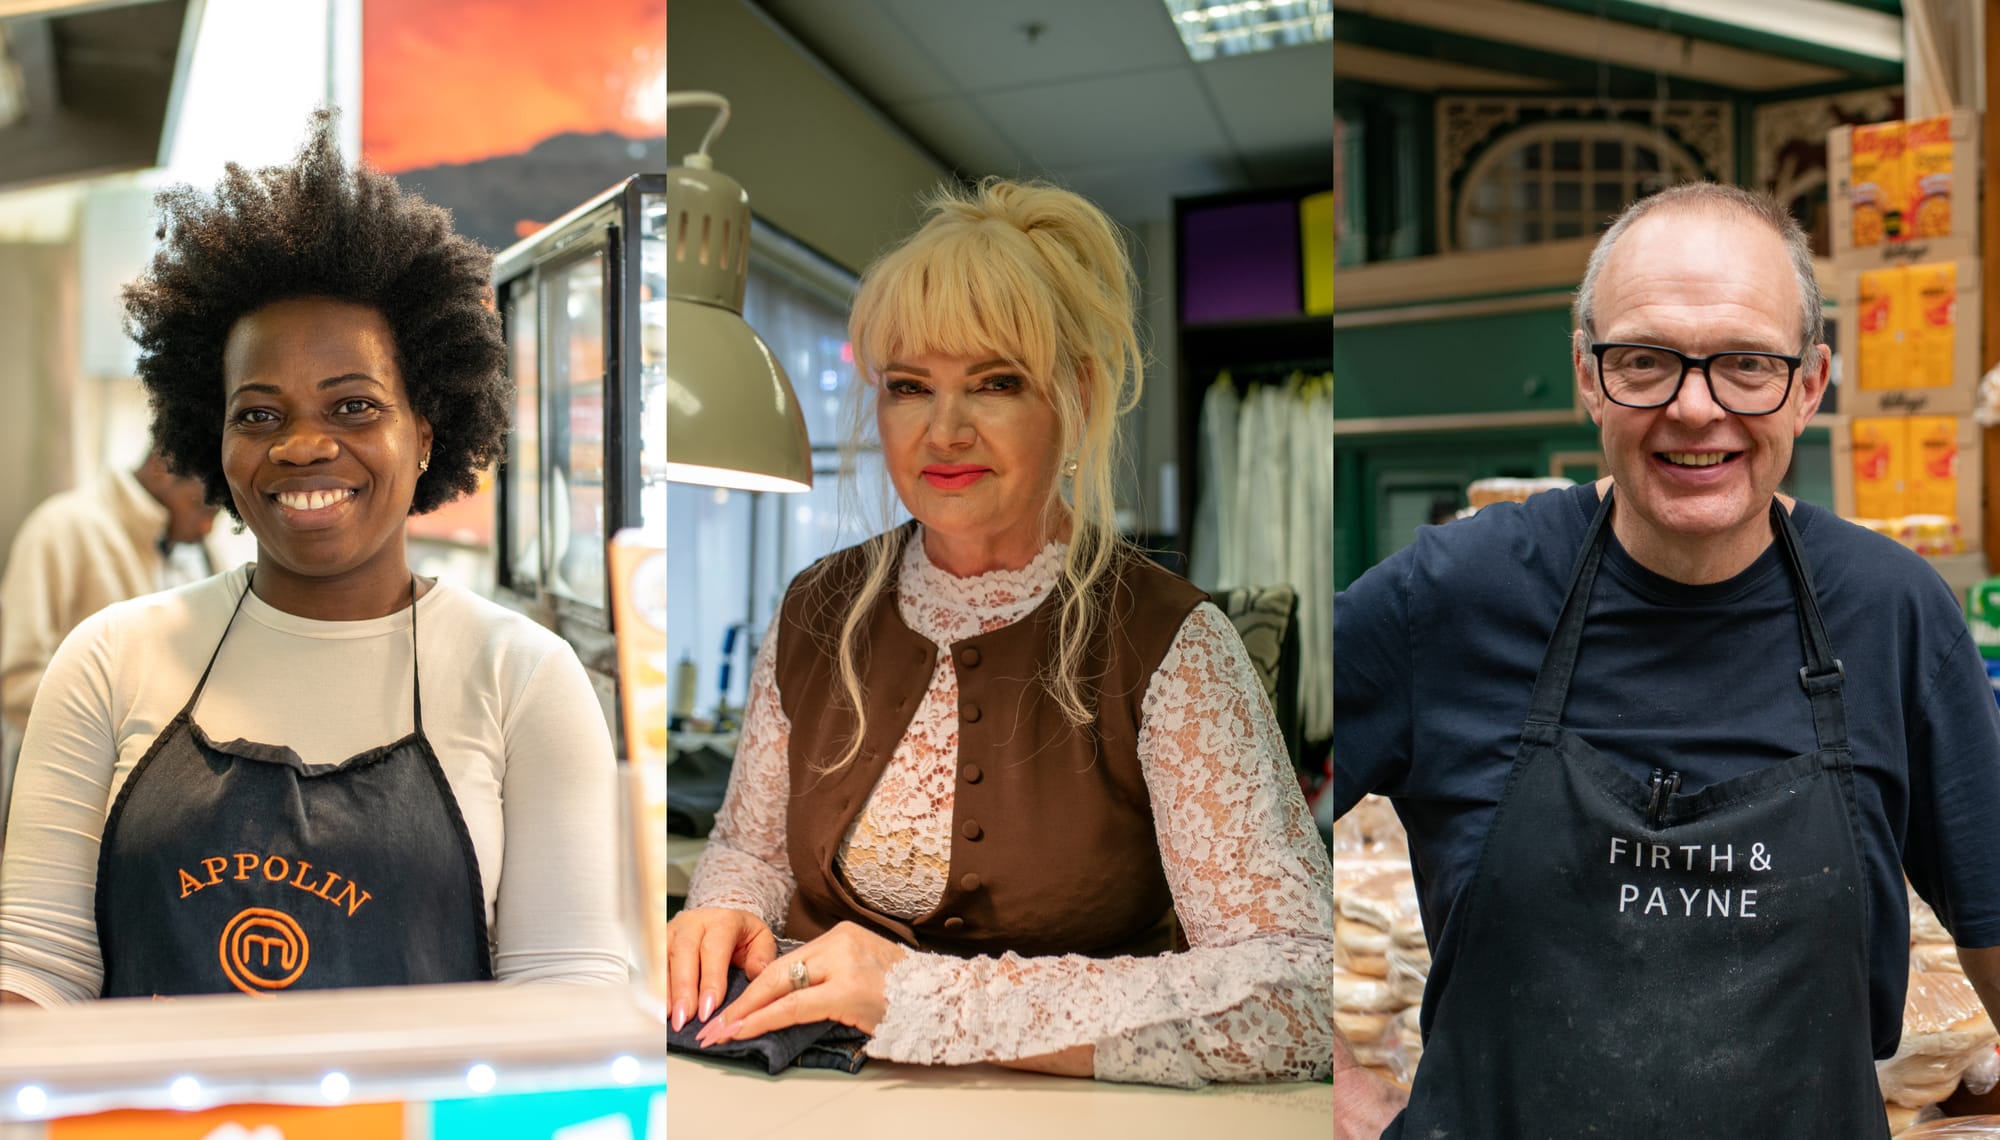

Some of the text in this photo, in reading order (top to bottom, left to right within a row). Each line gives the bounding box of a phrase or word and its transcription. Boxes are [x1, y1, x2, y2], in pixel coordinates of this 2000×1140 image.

[1609, 836, 1772, 873] FIRTH &
[177, 852, 373, 917] APPOLIN
[1619, 884, 1758, 918] PAYNE
